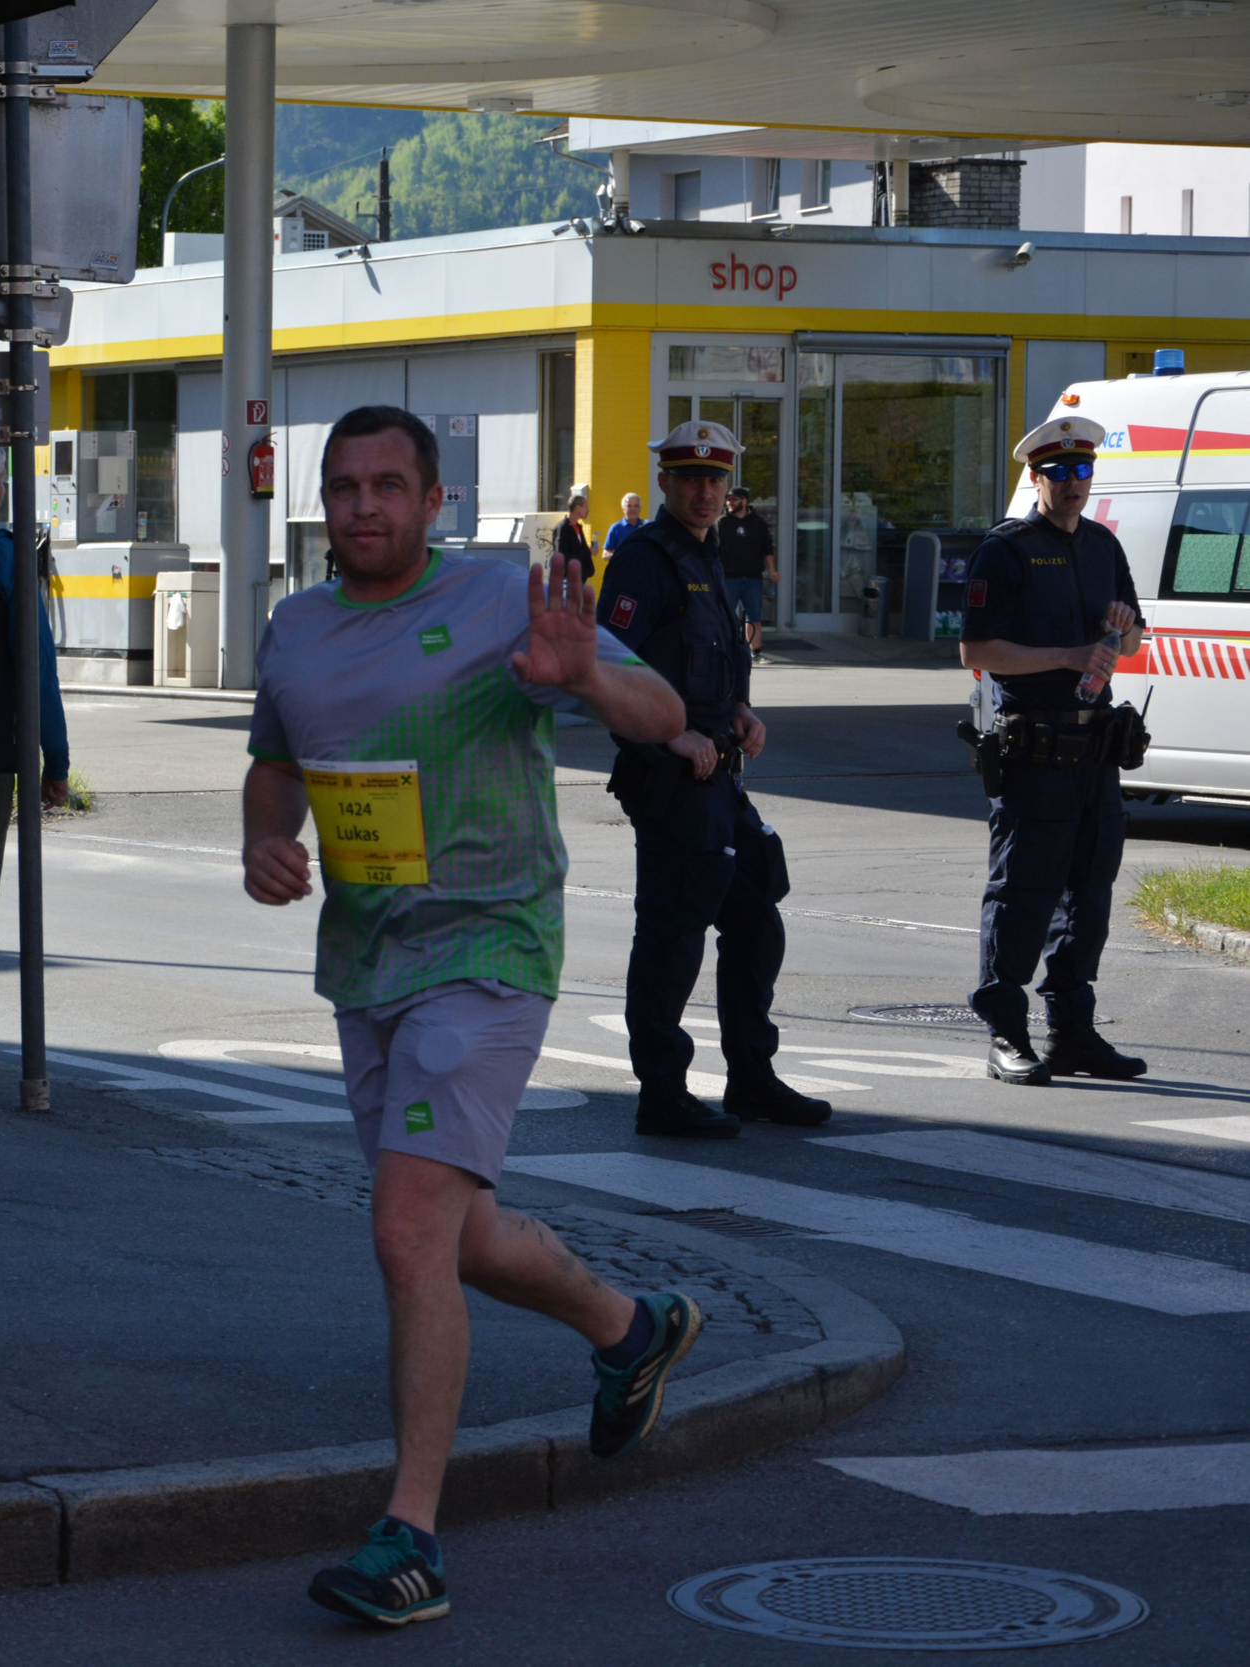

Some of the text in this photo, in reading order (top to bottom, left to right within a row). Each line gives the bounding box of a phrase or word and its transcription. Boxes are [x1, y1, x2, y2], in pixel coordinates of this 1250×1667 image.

[710, 252, 797, 301] shop
[1100, 431, 1125, 448] NCE
[1031, 558, 1067, 566] POLIZEI
[338, 802, 372, 816] 1424
[336, 825, 380, 841] Lukas
[366, 871, 392, 882] 1424
